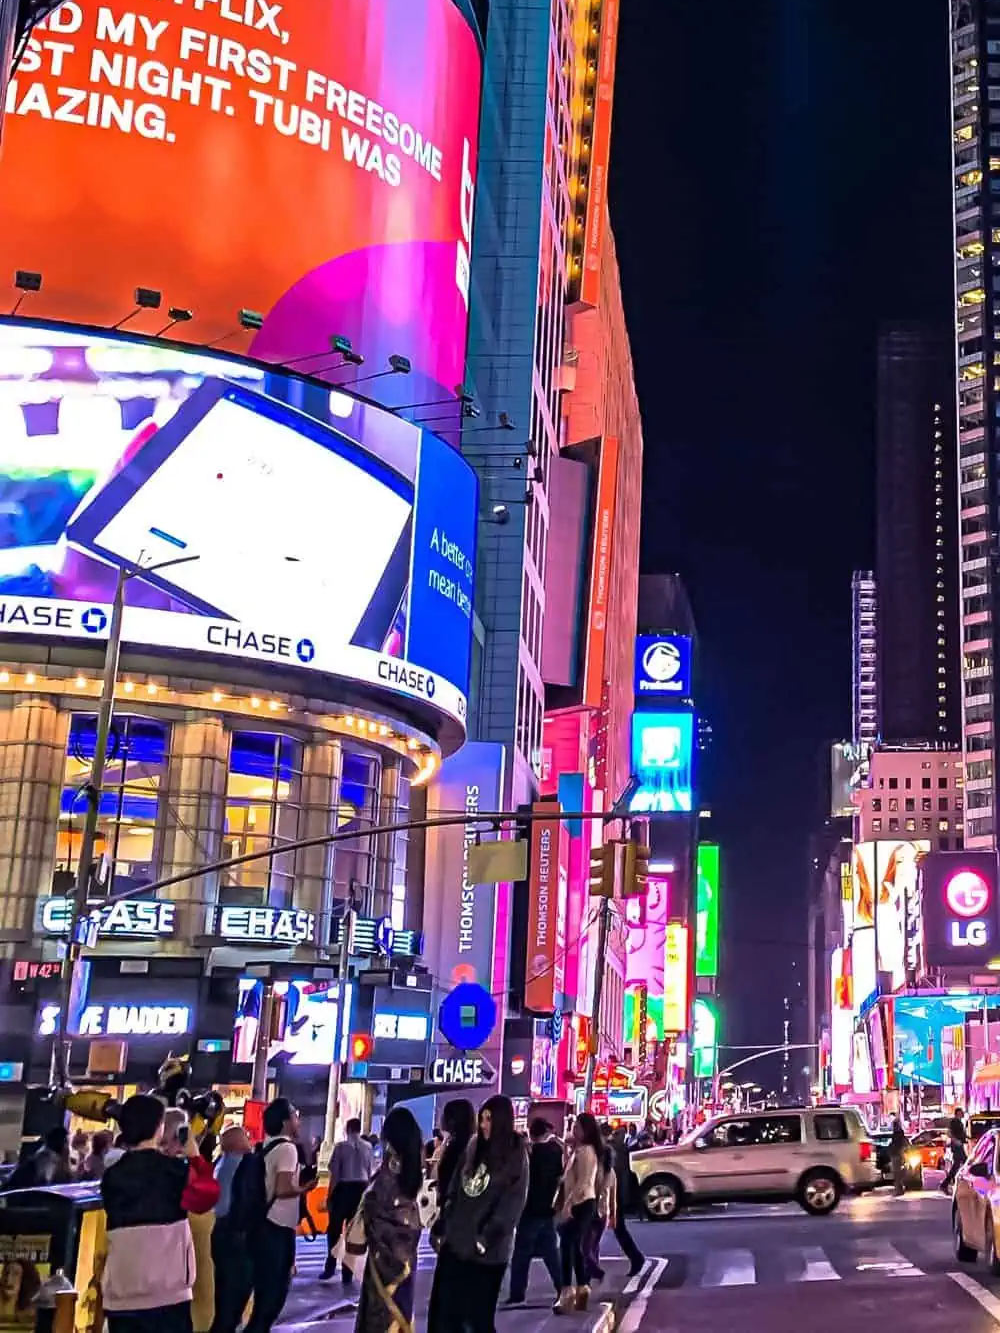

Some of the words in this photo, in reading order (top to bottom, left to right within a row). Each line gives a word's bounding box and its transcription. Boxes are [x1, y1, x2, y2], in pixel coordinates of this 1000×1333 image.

[96, 7, 169, 51] MY
[180, 26, 297, 92] FIRST
[305, 70, 443, 182] FREESOME
[90, 49, 235, 117] NIGHT.
[249, 89, 331, 151] TUBI
[341, 127, 401, 187] WAS
[429, 527, 440, 552] A
[441, 531, 465, 573] better
[428, 568, 456, 604] mean
[207, 625, 291, 657] CHASE
[377, 660, 425, 693] CHASE
[539, 829, 551, 883] REUTERS
[220, 907, 315, 941] CHASE
[536, 885, 548, 947] THOMSON
[951, 921, 987, 947] LG
[106, 1005, 189, 1035] MADDEN
[433, 1058, 482, 1083] CHASE
